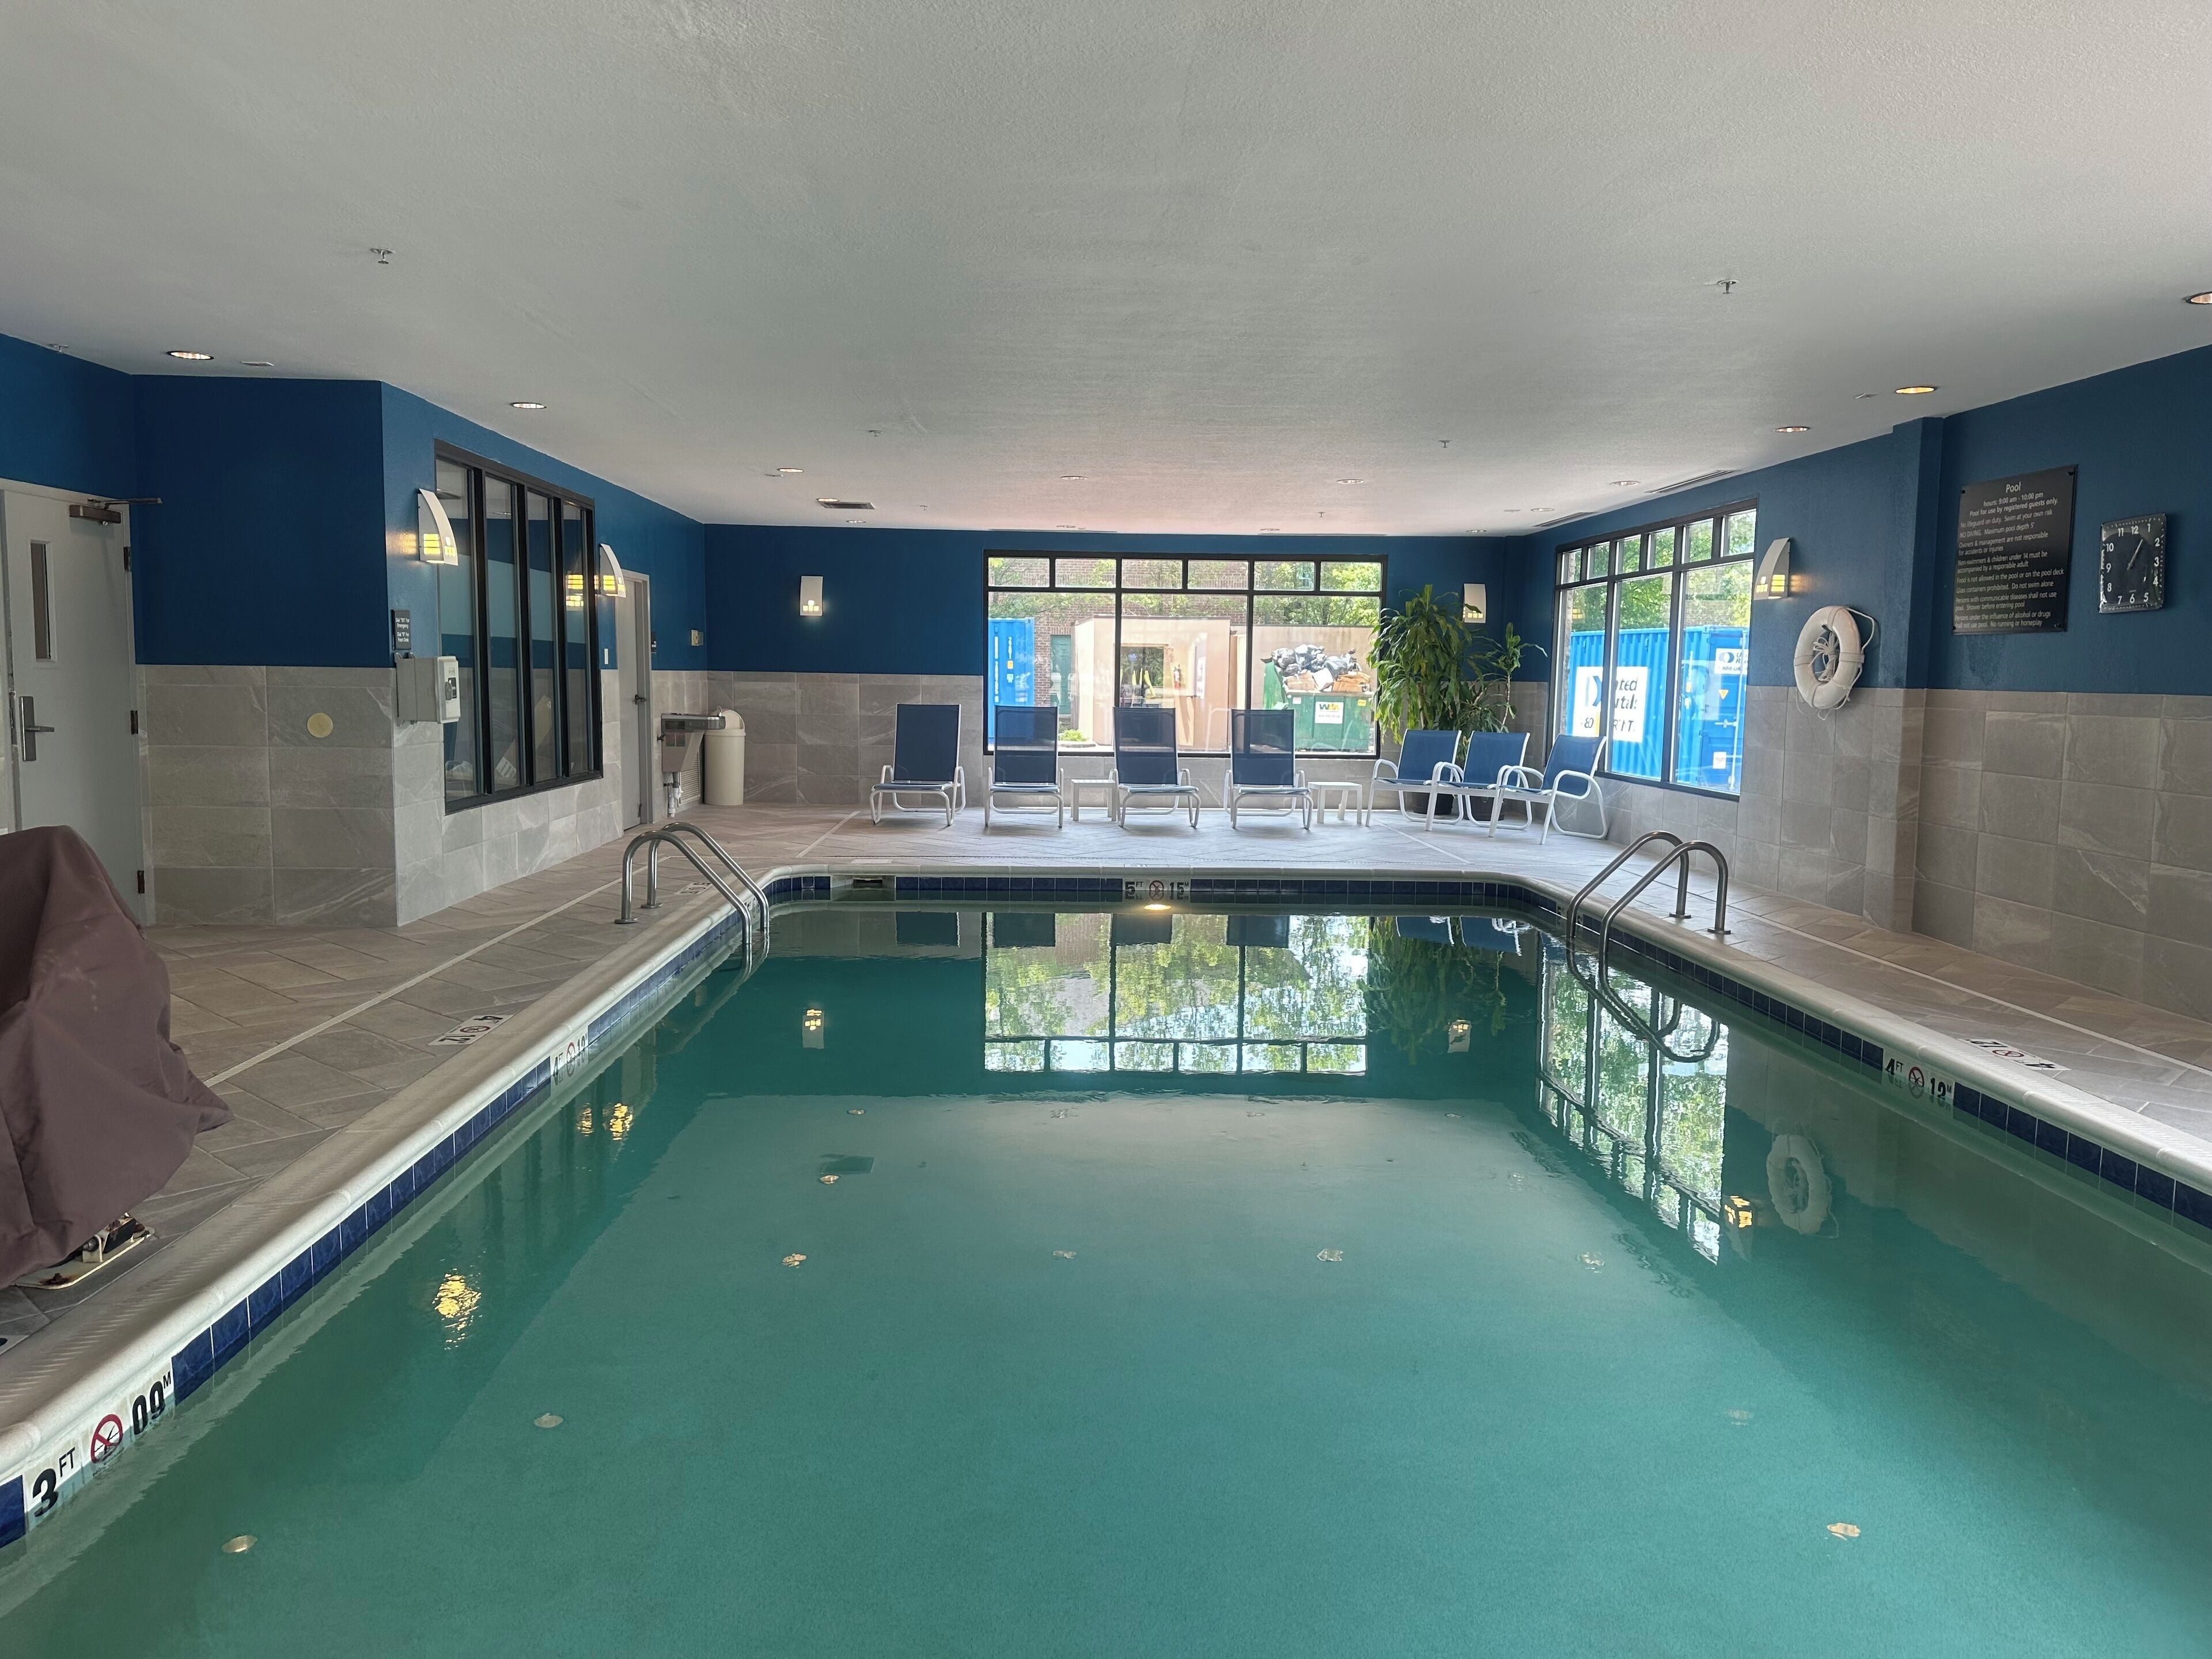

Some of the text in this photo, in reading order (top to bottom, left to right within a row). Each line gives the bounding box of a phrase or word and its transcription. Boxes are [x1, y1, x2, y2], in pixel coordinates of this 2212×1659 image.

[2006, 481, 2021, 493] Pool
[1969, 509, 1979, 517] Pool
[2003, 501, 2028, 513] registered
[2029, 500, 2045, 509] guests
[2022, 513, 2032, 521] your
[2016, 523, 2029, 531] depth
[2131, 525, 2139, 535] 12
[2147, 524, 2151, 533] 1
[2023, 531, 2048, 541] responsible
[2118, 528, 2124, 537] 11
[2106, 543, 2114, 552] 10
[2154, 538, 2160, 547] 2
[1993, 562, 2016, 570] responsible
[2017, 560, 2029, 568] adult
[2154, 556, 2159, 567] 3
[2106, 563, 2111, 573] 9
[2008, 573, 2018, 581] pool
[2041, 569, 2052, 578] pool
[2153, 576, 2159, 586] 4
[2107, 583, 2112, 592] 8
[2118, 596, 2122, 604] 7
[2130, 593, 2135, 604] 6
[2144, 593, 2149, 603] 5
[2015, 600, 2025, 609] pool
[2038, 611, 2051, 619] drugs
[1125, 881, 1135, 892] 5
[1885, 1058, 1903, 1076] 4 FT
[1931, 1077, 1952, 1100] 12 M
[132, 1371, 171, 1435] 09 M
[32, 1447, 75, 1517] 3 FT
